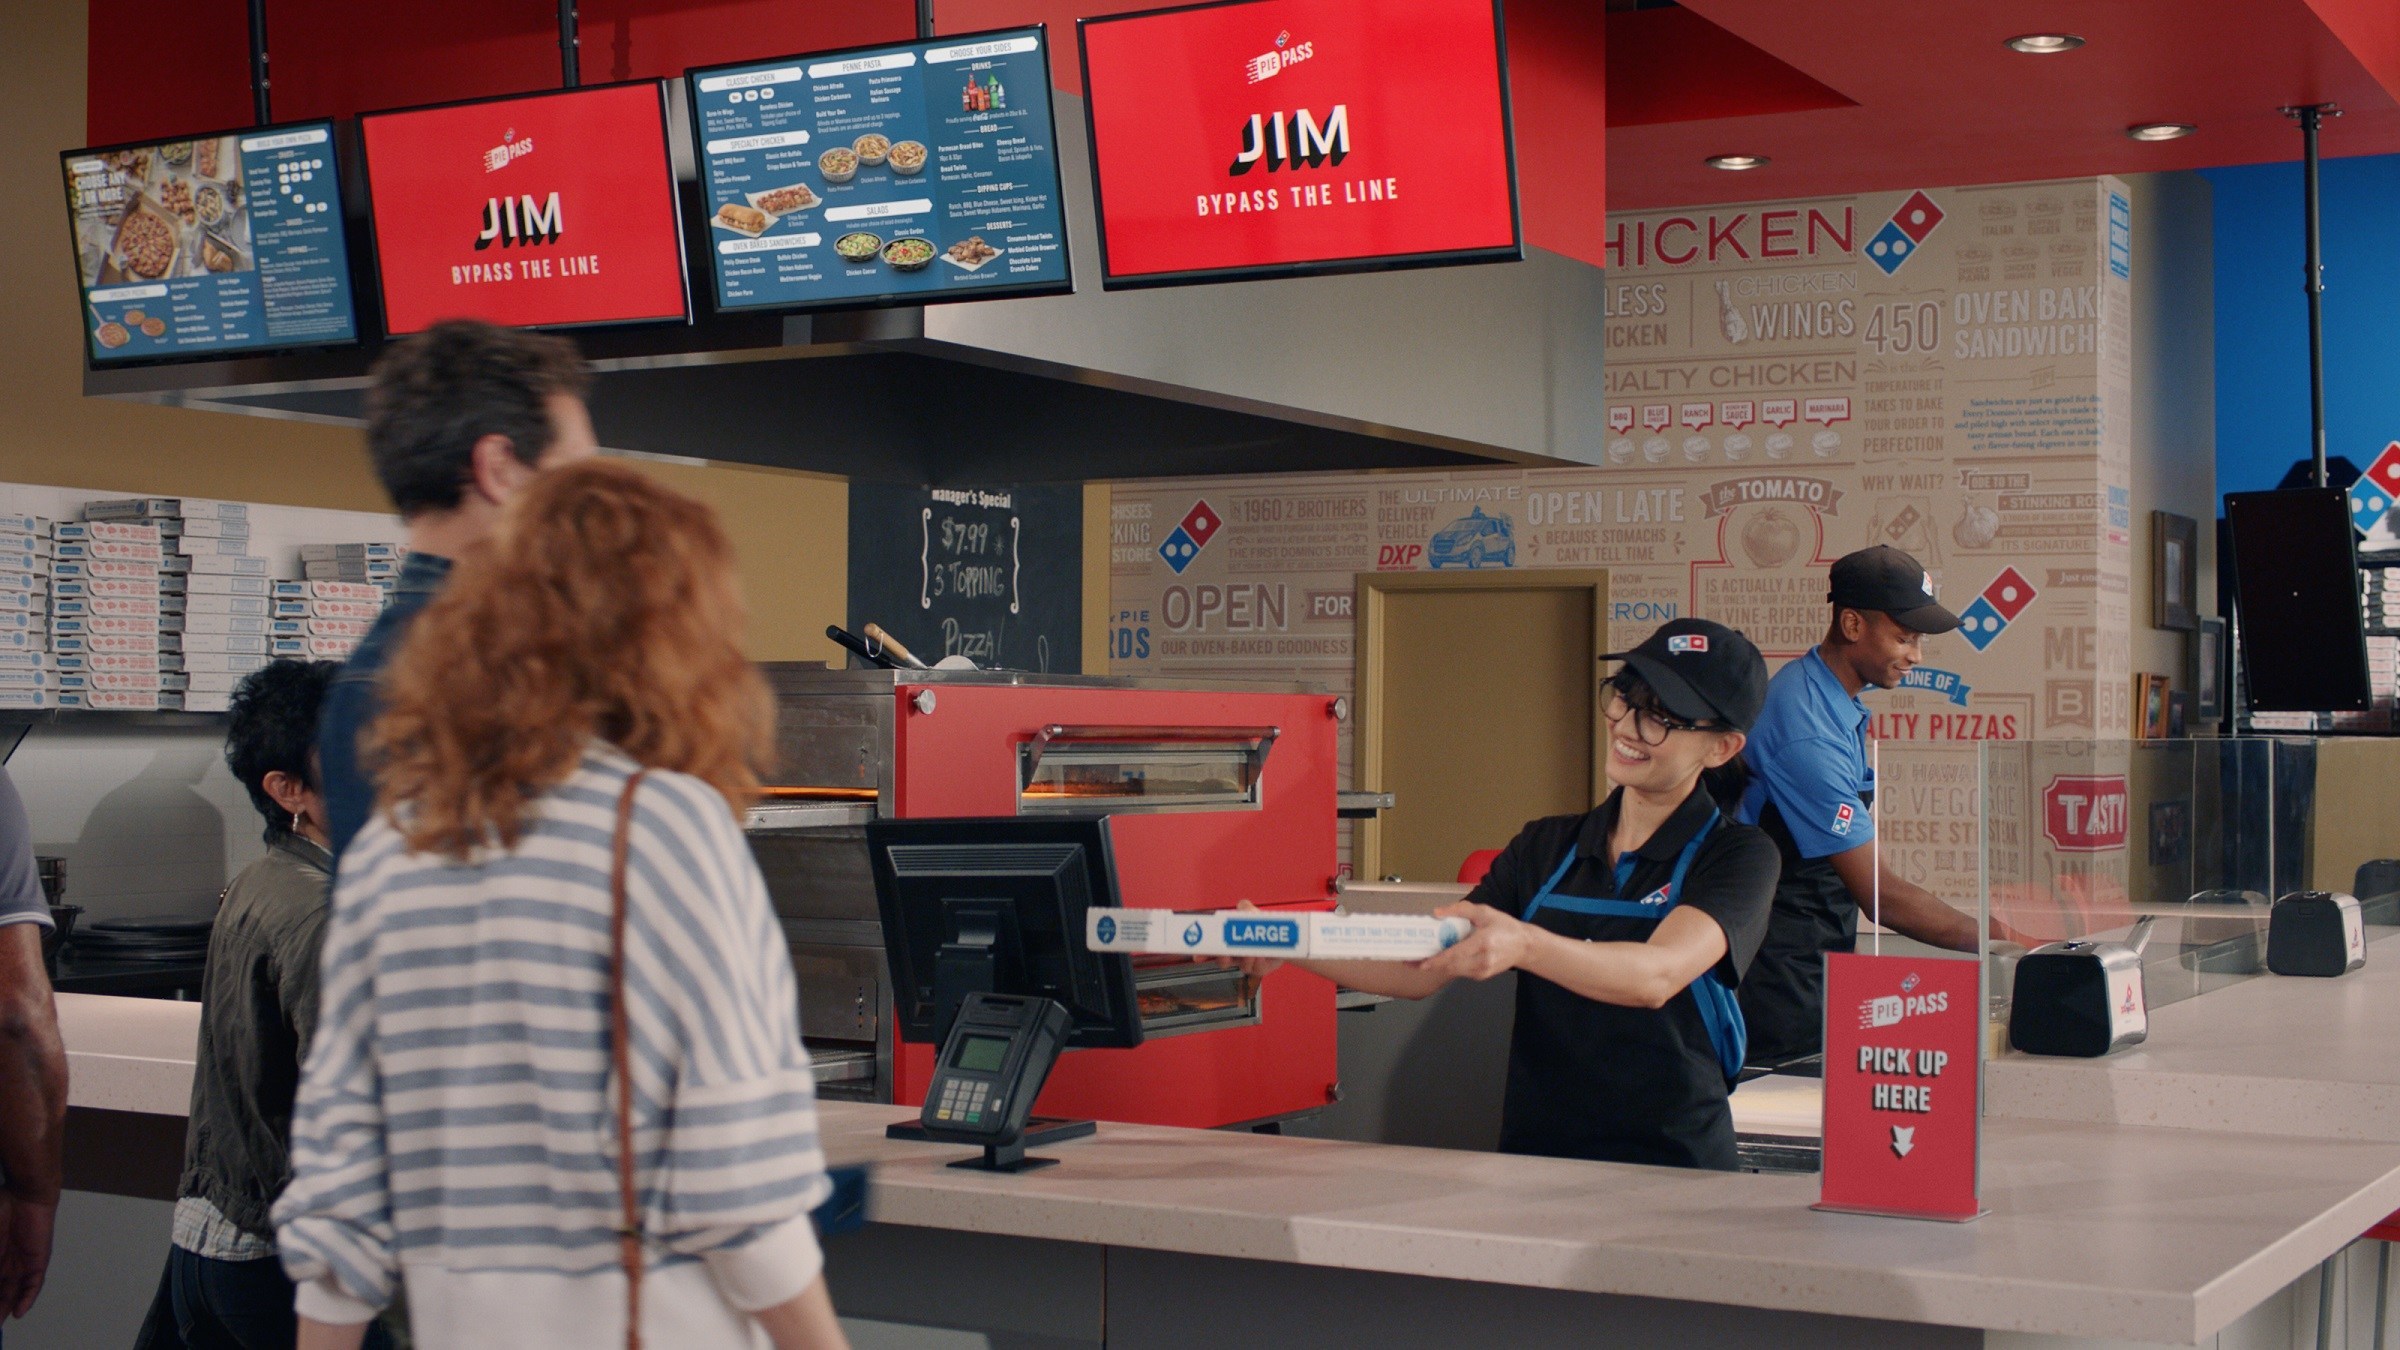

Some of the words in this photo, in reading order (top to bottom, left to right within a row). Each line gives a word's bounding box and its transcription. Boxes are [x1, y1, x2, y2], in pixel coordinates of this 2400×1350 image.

[950, 49, 973, 58] CHOOSE
[976, 46, 992, 55] YOUR
[993, 43, 1012, 52] SIDES
[1260, 55, 1278, 74] PIE
[1281, 41, 1314, 68] PASS
[842, 62, 861, 71] PENNE
[863, 59, 881, 69] PASTA
[972, 61, 991, 71] DRINKS
[726, 77, 749, 86] CLASSIC
[751, 73, 775, 83] CHICKEN
[813, 84, 829, 92] Chicken
[816, 110, 827, 118] Build
[980, 124, 998, 133] BREAD
[509, 138, 533, 158] PASS
[730, 139, 759, 149] SPECIALTY
[761, 136, 785, 146] CHICKEN
[1231, 105, 1350, 175] JIM
[977, 184, 998, 193] DIPPING
[999, 182, 1013, 191] CUPS
[1196, 189, 1279, 217] BYPASS
[1291, 184, 1332, 208] THE
[1345, 178, 1399, 202] LINE
[866, 206, 889, 215] SALADS
[475, 192, 563, 250] JIM
[986, 221, 1012, 230] DESSERTS
[733, 242, 748, 251] OVEN
[749, 241, 768, 249] BAKED
[769, 237, 806, 248] SANDWICHES
[452, 262, 512, 284] BYPASS
[521, 260, 551, 278] THE
[560, 255, 599, 276] LINE
[1736, 272, 1857, 297] CHICKEN
[1954, 290, 2029, 325] OVEN
[1752, 299, 1856, 341] WINGS
[1709, 360, 1856, 388] CHICKEN
[1865, 379, 1930, 393] TEMPERATURE
[1935, 379, 1943, 391] IT
[1648, 408, 1665, 416] BLUE
[1766, 405, 1791, 415] GARLIC
[1809, 404, 1845, 413] MARINARA
[1865, 399, 1896, 412] TAKES
[1900, 399, 1912, 411] TO
[1916, 398, 1944, 410] BAKE
[1614, 412, 1628, 421] BBQ
[1684, 410, 1709, 418] RANCH
[1725, 410, 1748, 420] SAUCE
[1865, 418, 1890, 431] YOUR
[1894, 418, 1927, 430] ORDER
[1932, 417, 1944, 428] TO
[1864, 435, 1944, 453] PERFECTION
[1738, 480, 1823, 500] TOMATO
[1862, 475, 1894, 491] WHY
[1900, 474, 1944, 490] WAIT?
[1973, 477, 1990, 489] DUE
[1994, 478, 2005, 488] TO
[2010, 477, 2026, 488] THE
[932, 489, 977, 506] manager's
[979, 490, 1011, 509] Special
[1379, 490, 1400, 505] THE
[1405, 487, 1521, 503] ULTIMATE
[2010, 496, 2071, 509] STINKING
[1244, 498, 1281, 522] 1960
[1287, 501, 1293, 519] 2
[1298, 499, 1367, 518] BROTHERS
[1378, 507, 1436, 523] DELIVERY
[1528, 491, 1602, 525] OPEN
[1616, 489, 1684, 523] LATE
[941, 516, 988, 555] $7.99
[1112, 522, 1150, 544] KING
[1377, 523, 1428, 539] VEHICLE
[1545, 531, 1597, 545] BECAUSE
[1602, 529, 1666, 544] STOMACHS
[1229, 548, 1247, 558] THE
[1251, 547, 1279, 558] FIRST
[1281, 546, 1331, 558] DOMINO'S
[1335, 545, 1368, 556] STORE
[2001, 540, 2024, 550] ITS
[2027, 539, 2090, 550] SIGNATURE
[1112, 547, 1153, 563] STORE
[1378, 544, 1422, 565] DXP
[1556, 548, 1590, 562] CAN'T
[1595, 547, 1621, 561] TELL
[1626, 546, 1655, 561] TIME
[934, 564, 944, 596] 3
[1611, 574, 1642, 585] KNOW
[1706, 579, 1717, 593] IS
[1722, 578, 1782, 593] ACTUALLY
[1788, 579, 1795, 592] A
[2060, 571, 2078, 584] Just
[1652, 589, 1678, 598] FOR
[1120, 611, 1150, 621] PIE
[1161, 584, 1289, 633] OPEN
[1314, 596, 1351, 616] FOR
[1740, 627, 1824, 643] ALIFORNI
[1160, 640, 1188, 656] OUR
[1191, 639, 1273, 656] OVEN-BAKED
[1277, 639, 1348, 655] GOODNESS
[1905, 670, 1932, 685] ONE
[1935, 674, 1954, 690] OF
[1890, 695, 1915, 709] OUR
[2057, 690, 2082, 716] B
[1930, 714, 2016, 739] PIZZAS
[2057, 794, 2127, 835] TASTY
[1232, 925, 1290, 943] LARGE
[1877, 1001, 1898, 1020] PIE
[1906, 992, 1948, 1015] PASS
[1858, 1046, 1911, 1076] PICK
[1916, 1050, 1948, 1077] UP
[1873, 1083, 1931, 1113] HERE
